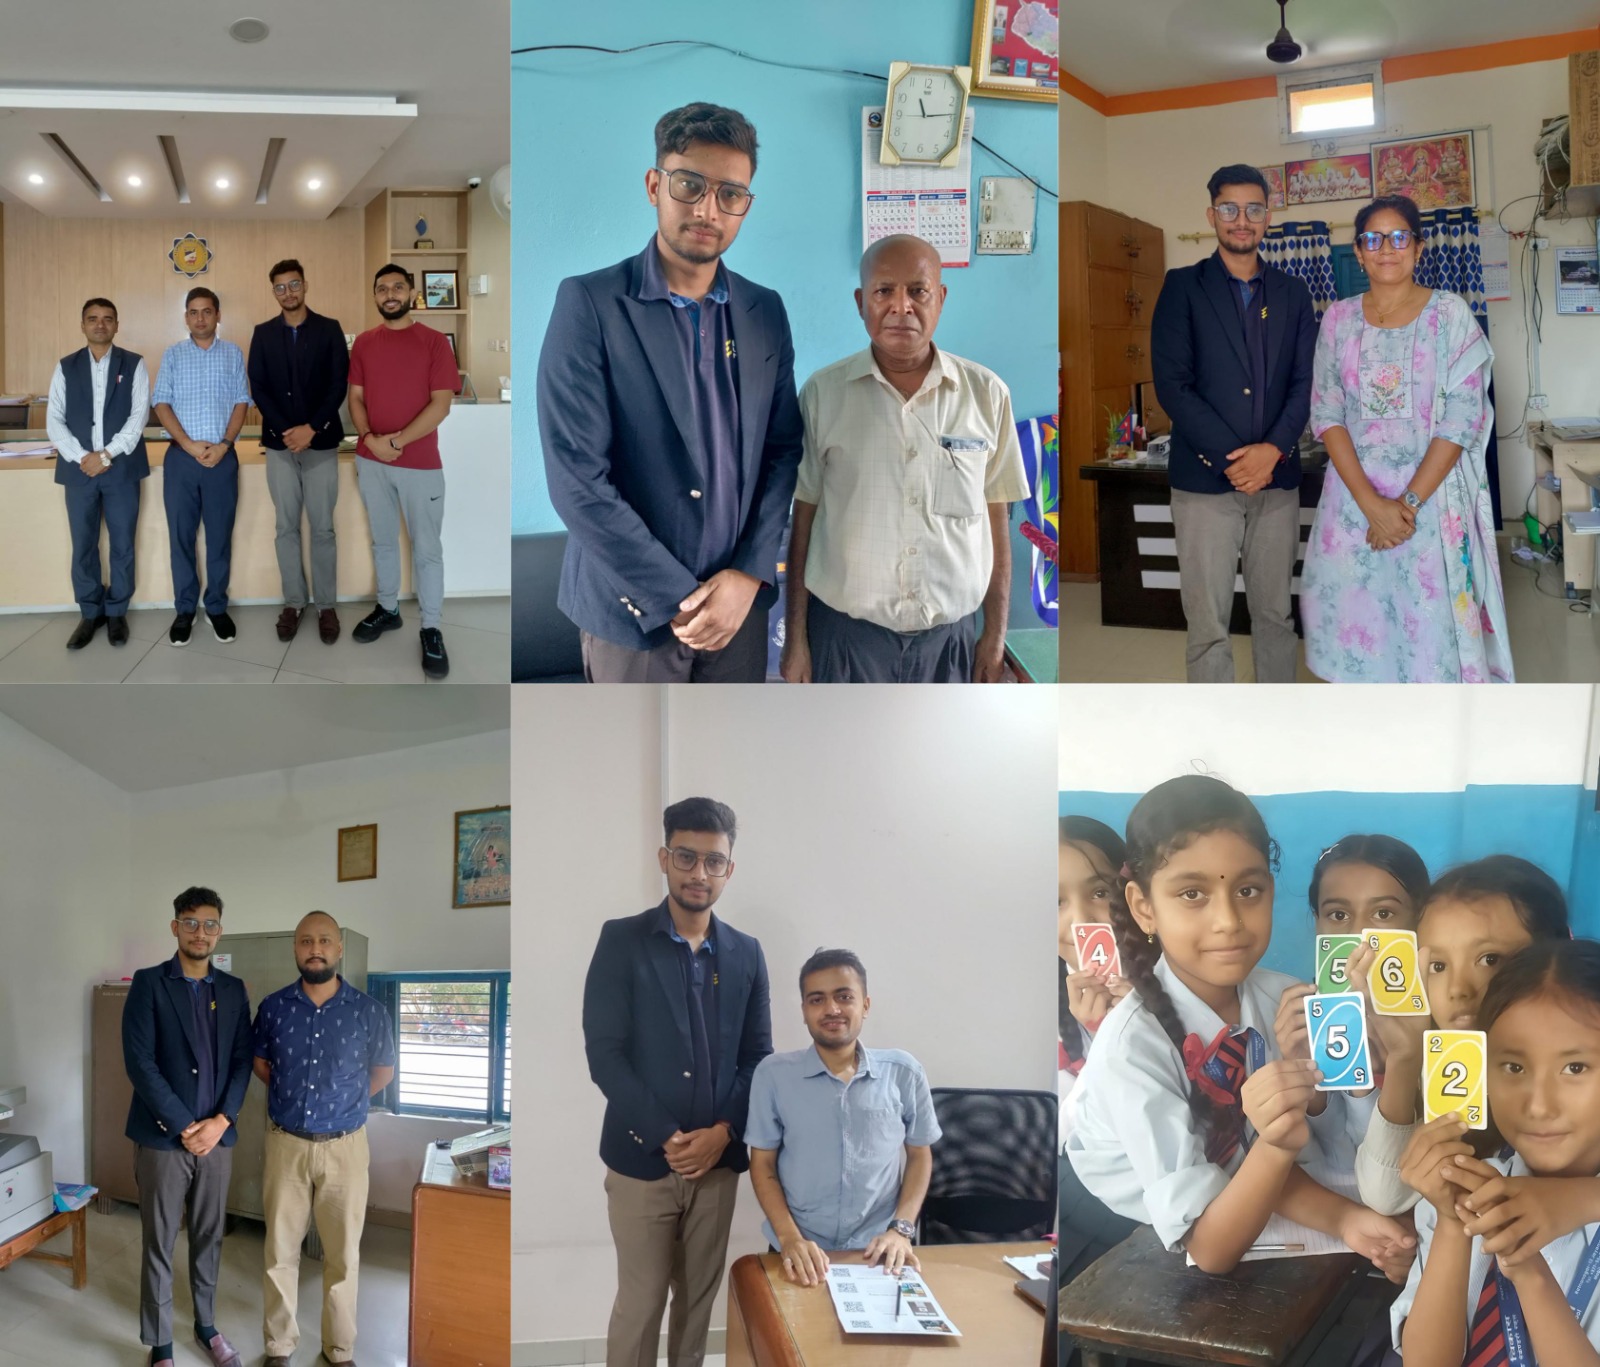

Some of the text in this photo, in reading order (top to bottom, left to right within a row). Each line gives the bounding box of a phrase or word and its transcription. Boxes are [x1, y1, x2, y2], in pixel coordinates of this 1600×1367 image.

[925, 78, 933, 89] 12
[949, 96, 955, 107] 2
[896, 110, 903, 120] 9
[894, 127, 900, 137] 8
[943, 130, 950, 140] 4
[901, 143, 908, 153] 7
[917, 144, 924, 153] 6
[933, 144, 939, 154] 5
[1078, 928, 1087, 938] 4
[1322, 939, 1331, 951] 5
[1369, 935, 1379, 950] 6
[1090, 943, 1108, 966] 4
[1329, 958, 1348, 984] 5
[1381, 956, 1406, 992] 6
[1312, 1001, 1323, 1017] 5
[1326, 1025, 1350, 1060] 5
[1430, 1036, 1443, 1053] 2
[1441, 1061, 1468, 1097] 2
